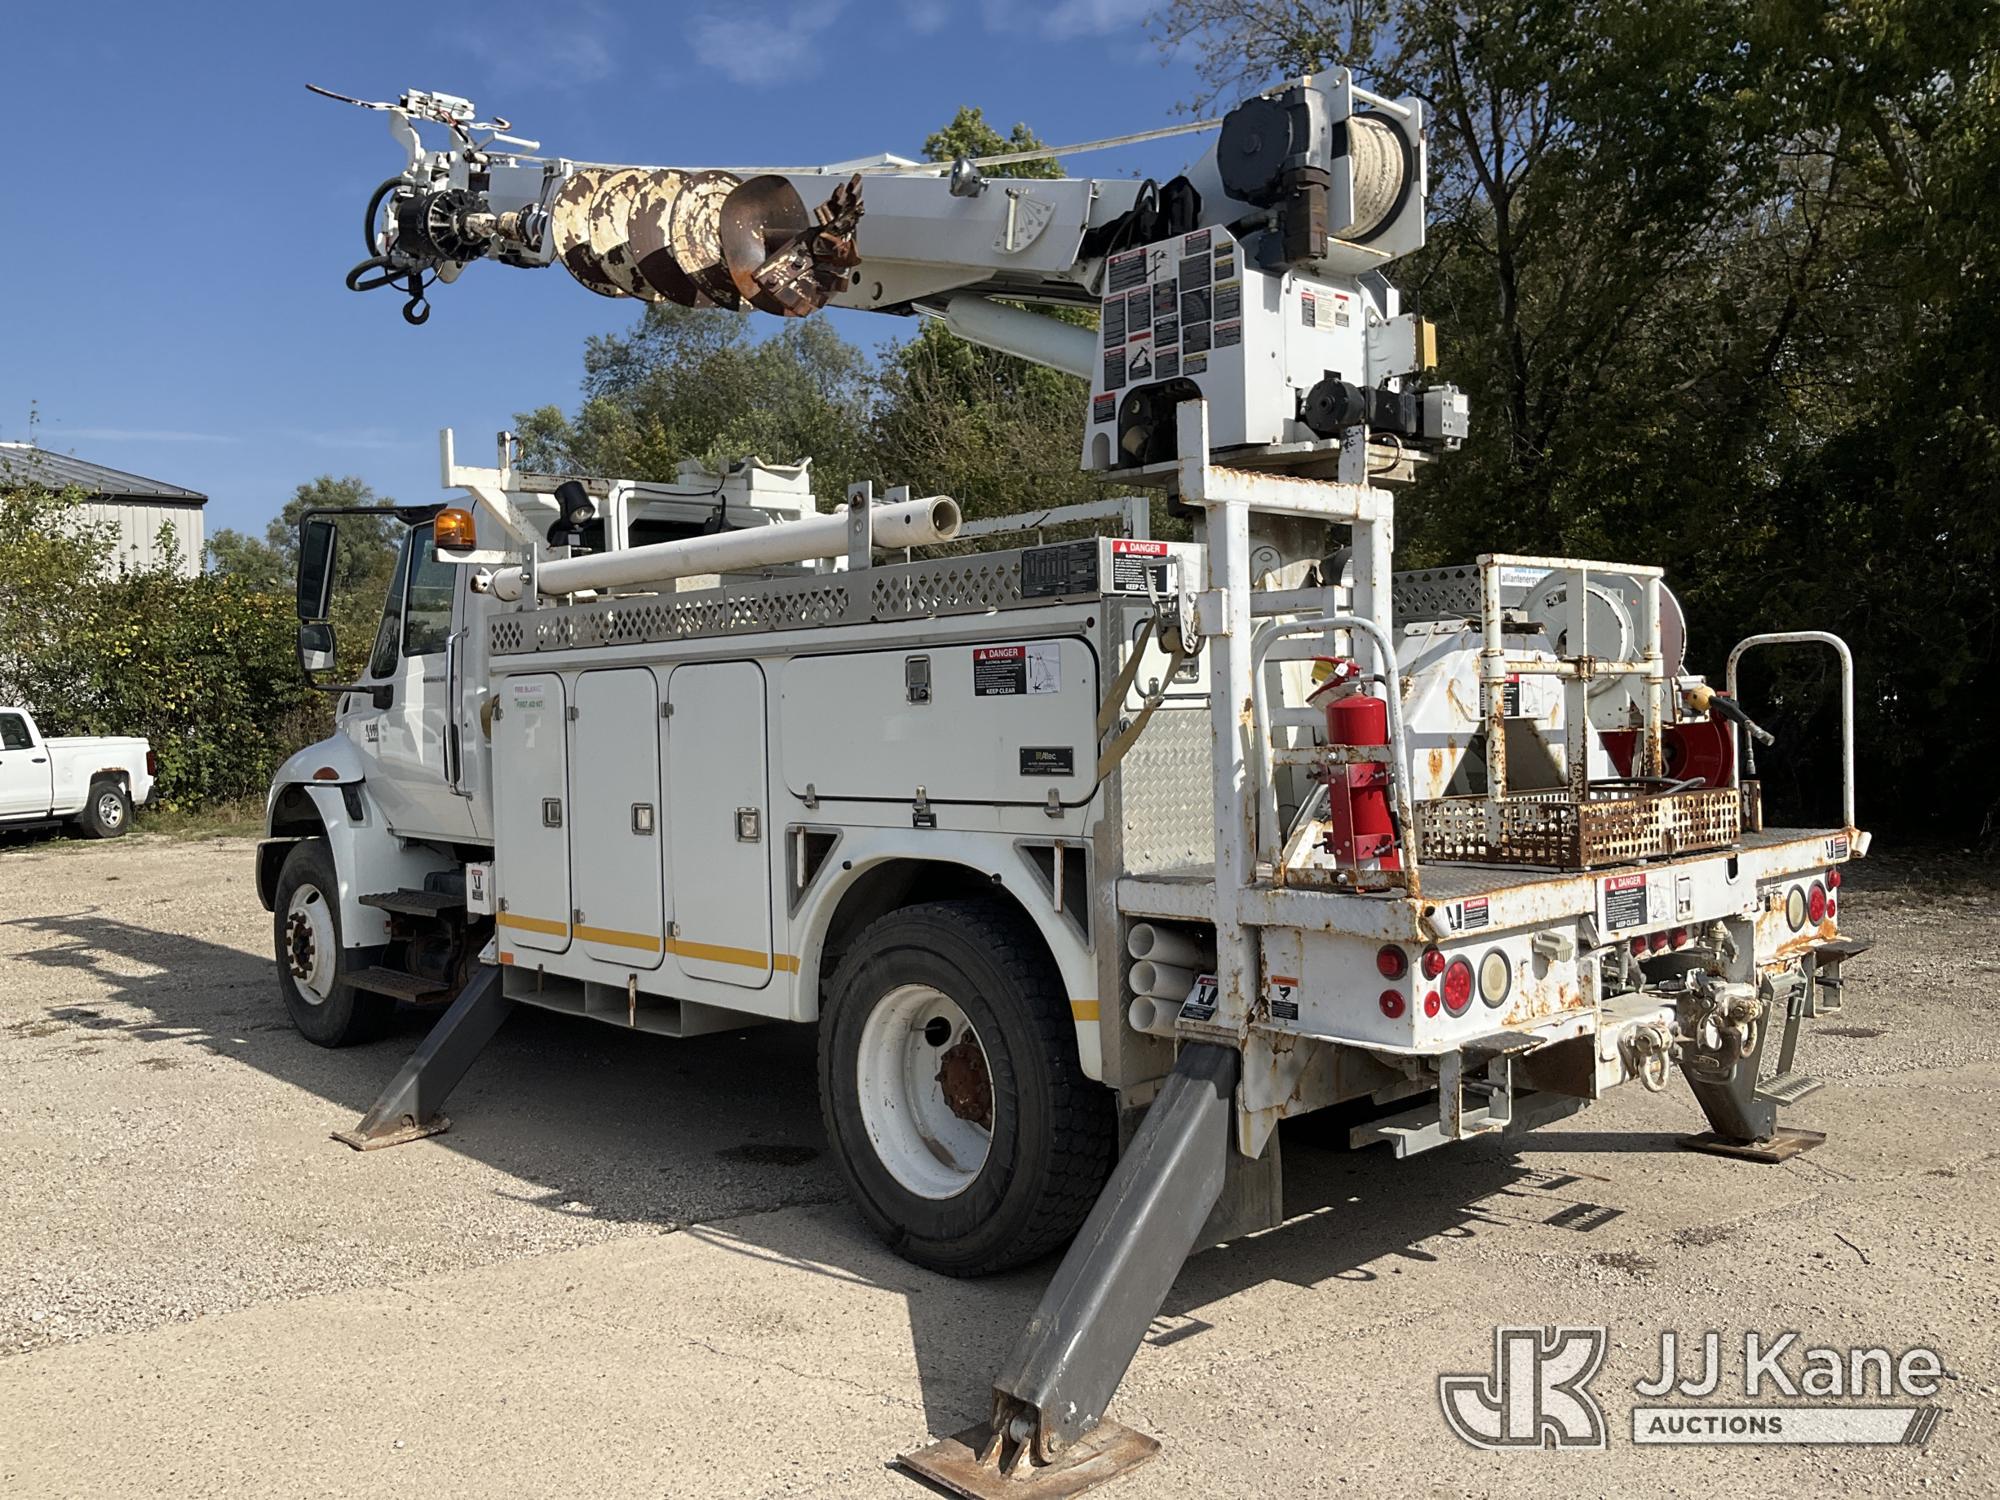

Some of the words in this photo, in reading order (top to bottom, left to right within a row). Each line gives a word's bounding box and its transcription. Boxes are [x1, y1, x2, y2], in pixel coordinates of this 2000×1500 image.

[1130, 543, 1161, 553] DANGER
[989, 648, 1018, 658] DANGER
[1618, 876, 1641, 887] DANGER
